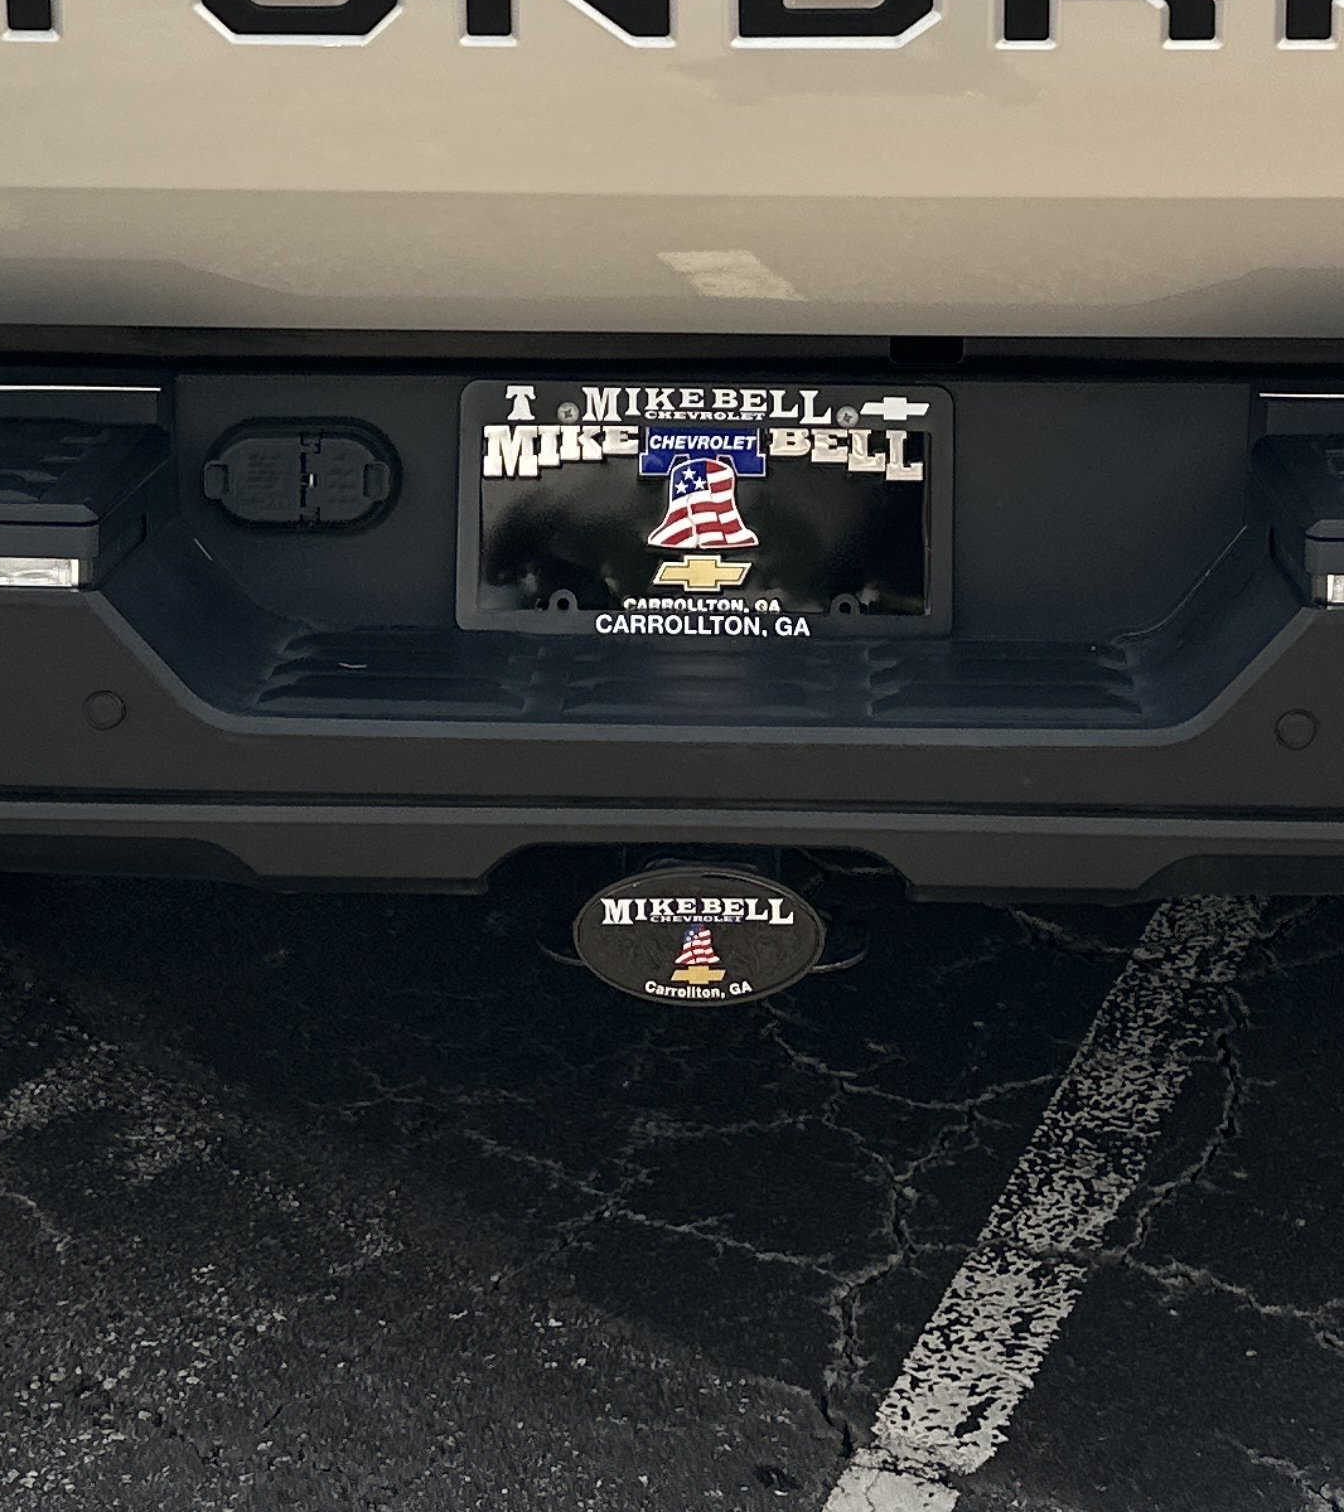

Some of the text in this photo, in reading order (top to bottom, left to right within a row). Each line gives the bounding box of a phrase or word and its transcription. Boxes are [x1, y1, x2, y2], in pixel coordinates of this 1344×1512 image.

[582, 387, 832, 425] MIKE BELL
[644, 410, 766, 420] CHEVROLET
[483, 425, 923, 481] MIKE BELL
[649, 435, 757, 450] CHEVROLET
[754, 599, 781, 613] GA
[595, 614, 810, 637] CARROLLTON, GA
[601, 897, 794, 925] MIKE BELL
[644, 980, 752, 999] Carrollton, GA
